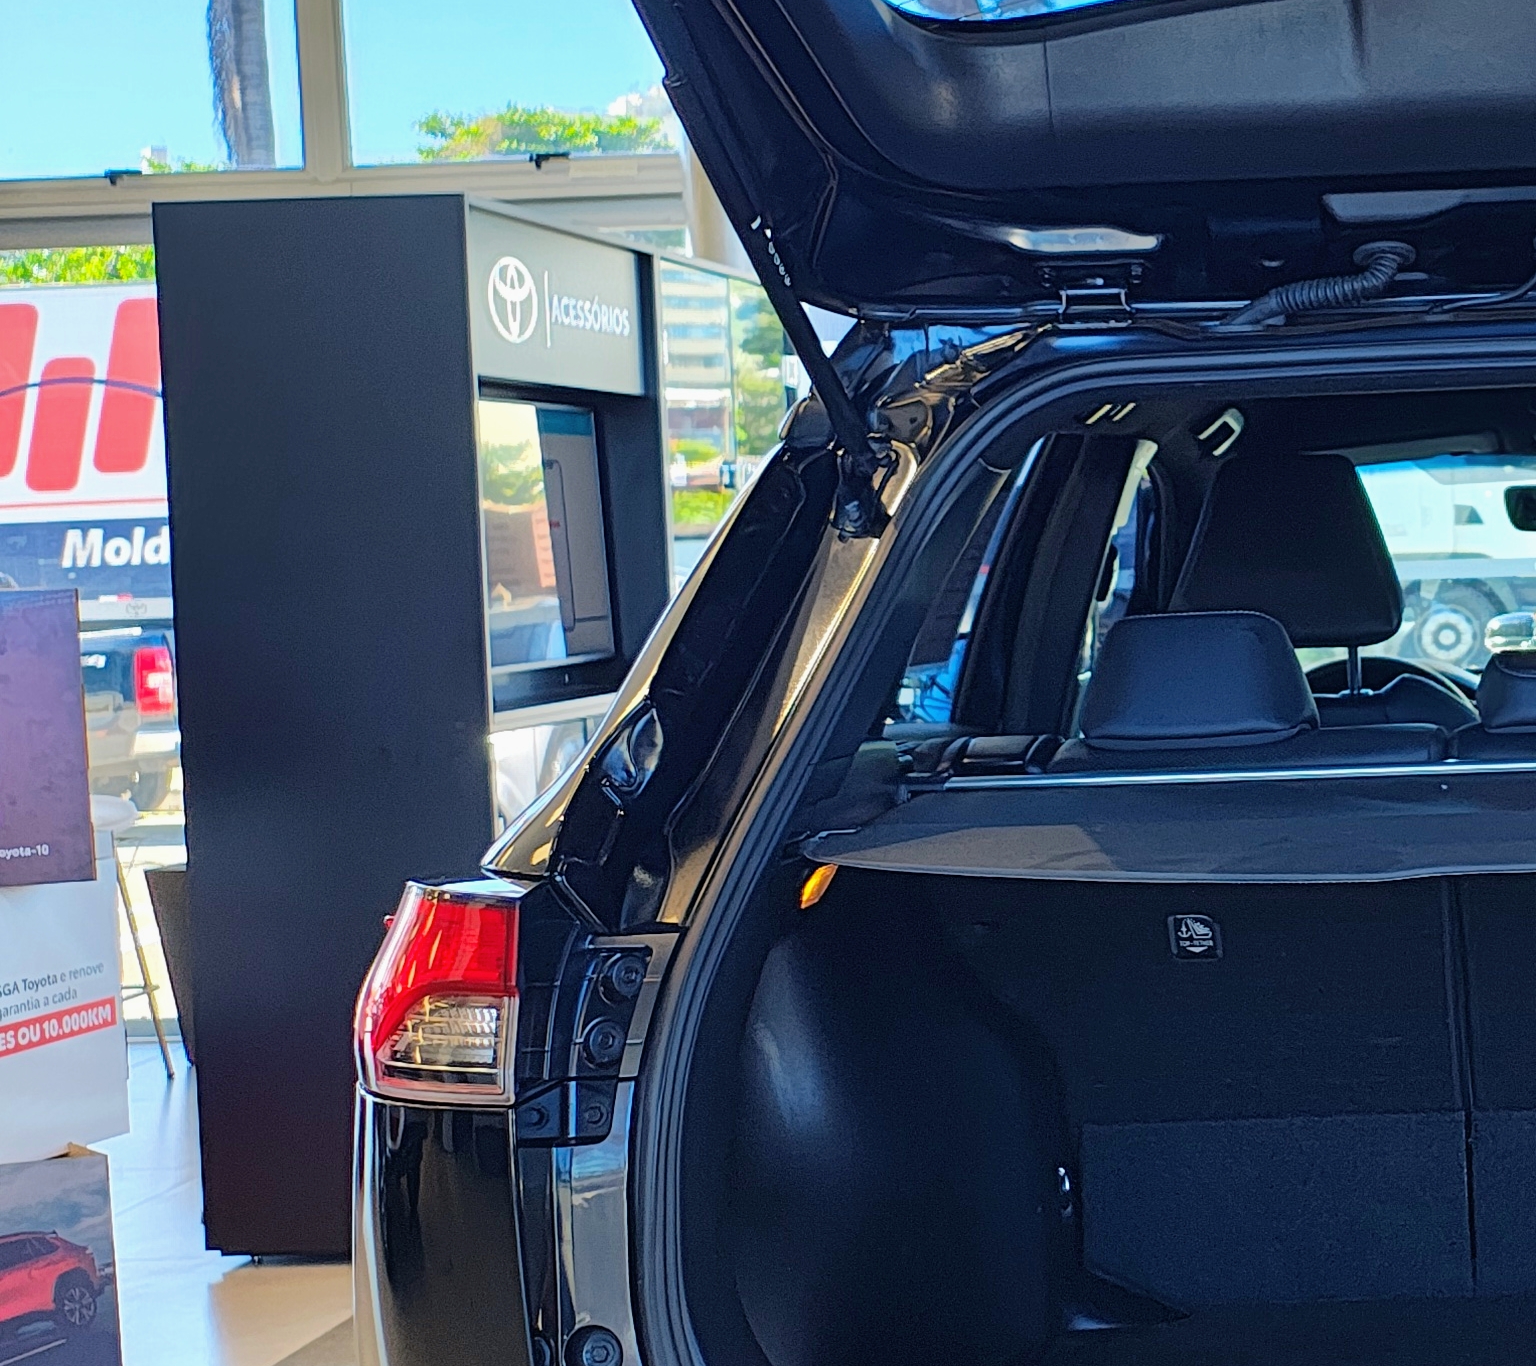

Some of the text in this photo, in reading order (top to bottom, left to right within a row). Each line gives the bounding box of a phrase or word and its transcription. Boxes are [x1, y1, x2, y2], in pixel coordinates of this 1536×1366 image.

[551, 294, 630, 337] ACESSÓRIOS
[62, 525, 170, 568] Mold
[0, 962, 105, 998] GA Toyota e renove
[43, 995, 50, 1007] a
[52, 985, 78, 1005] cada
[17, 1022, 41, 1046] OU
[42, 1003, 112, 1040] 10.000KM
